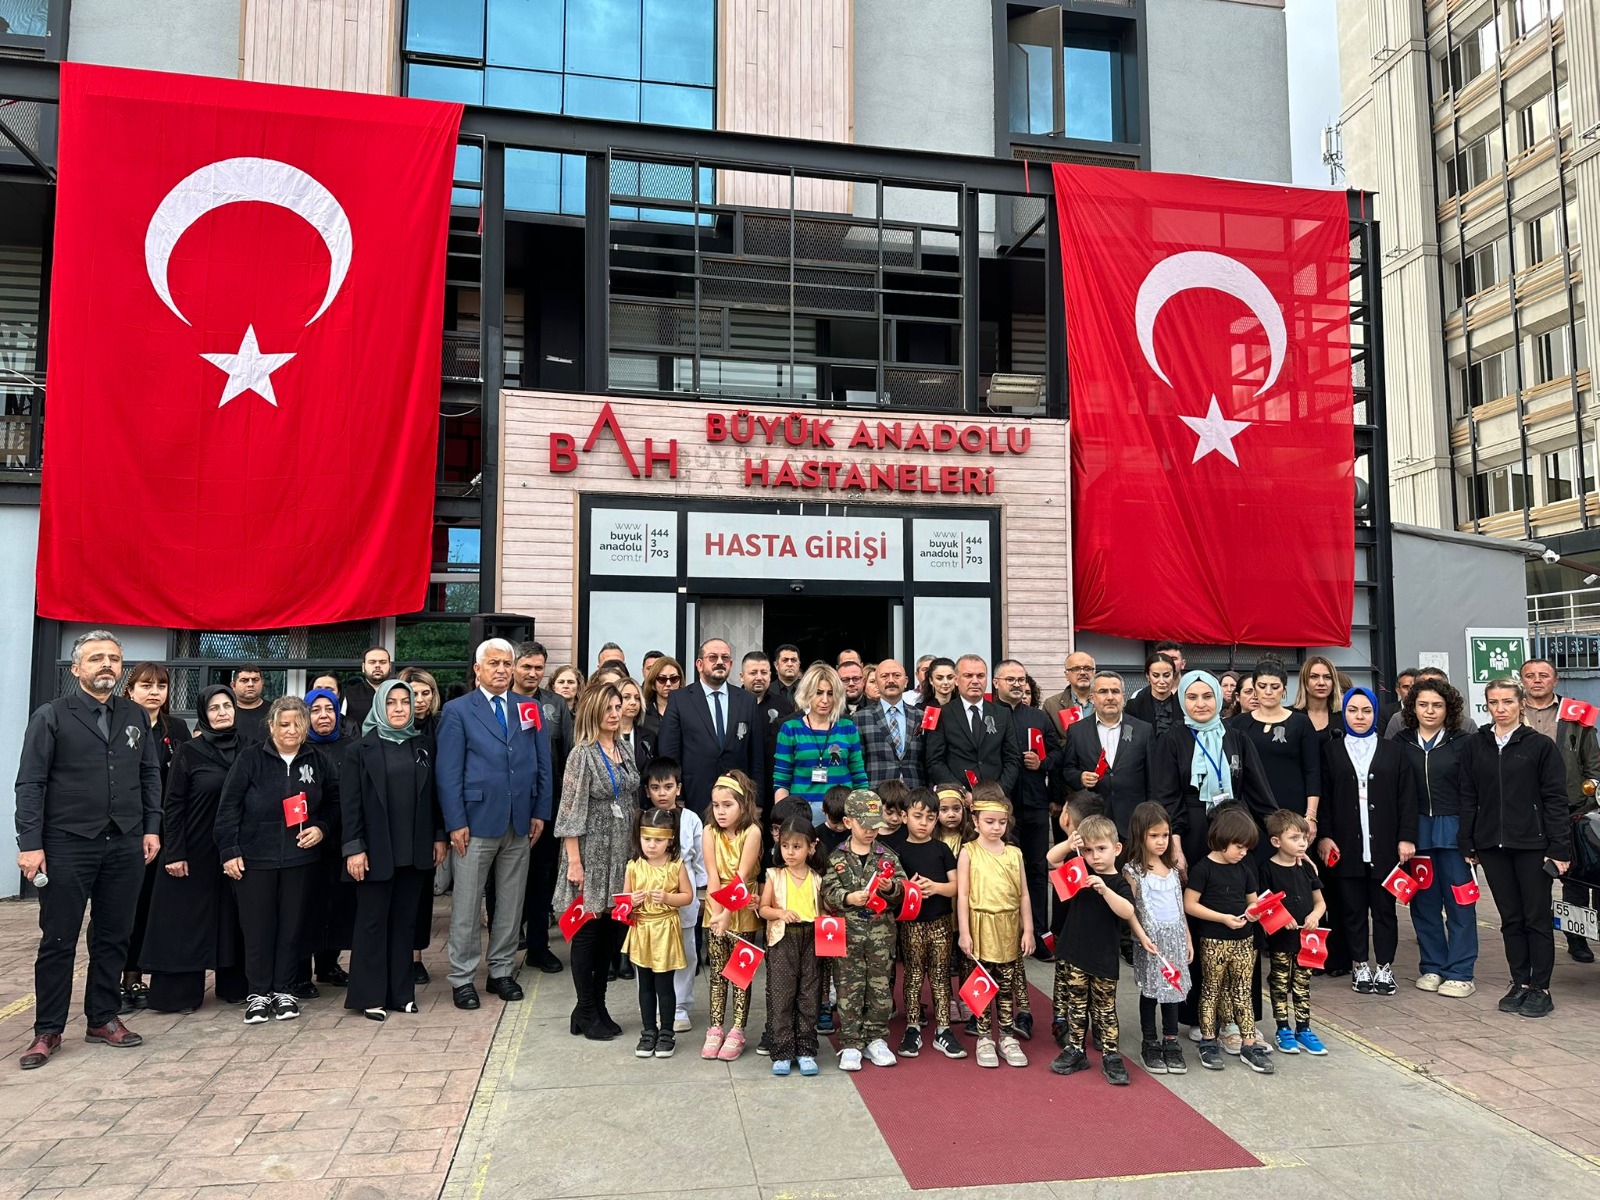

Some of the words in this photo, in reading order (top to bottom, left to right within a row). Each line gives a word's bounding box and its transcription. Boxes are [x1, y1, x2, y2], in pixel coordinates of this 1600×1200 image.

[706, 409, 835, 448] BÜYÜK
[848, 420, 1031, 454] ANADOLU
[610, 531, 643, 542] buyuk
[650, 529, 669, 537] 444
[650, 539, 657, 548] 3
[929, 539, 959, 550] buyuk
[965, 536, 983, 545] 444
[599, 542, 642, 552] anadolu
[705, 532, 798, 557] HASTA
[805, 530, 887, 567] GİRİŞİ
[966, 546, 972, 555] 3
[650, 549, 669, 559] 703
[920, 549, 959, 558] anadolu
[965, 555, 983, 565] 703
[1556, 903, 1570, 917] 55
[1584, 910, 1595, 924] TC
[1567, 920, 1585, 935] 008
